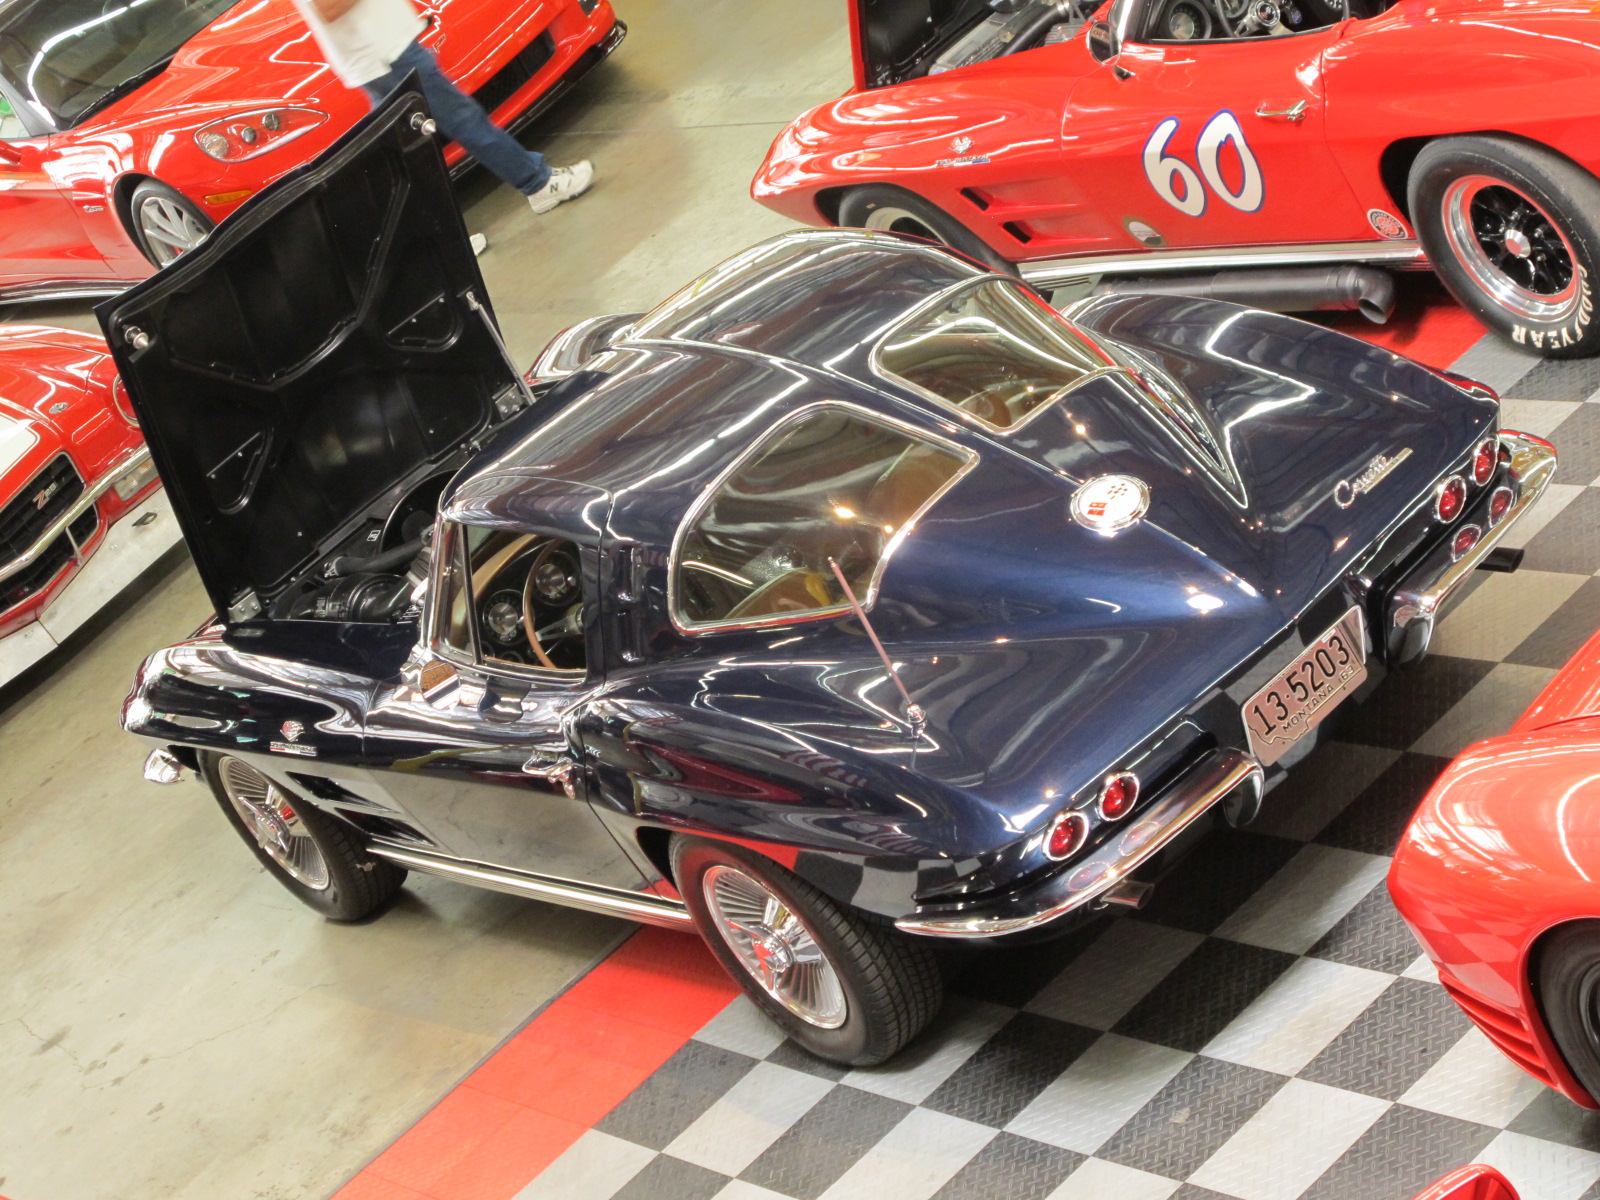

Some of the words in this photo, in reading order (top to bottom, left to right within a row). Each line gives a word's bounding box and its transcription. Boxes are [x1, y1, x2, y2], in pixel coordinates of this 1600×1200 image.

[550, 182, 559, 193] N
[1142, 108, 1266, 217] 60
[1282, 683, 1334, 733] MONTANA
